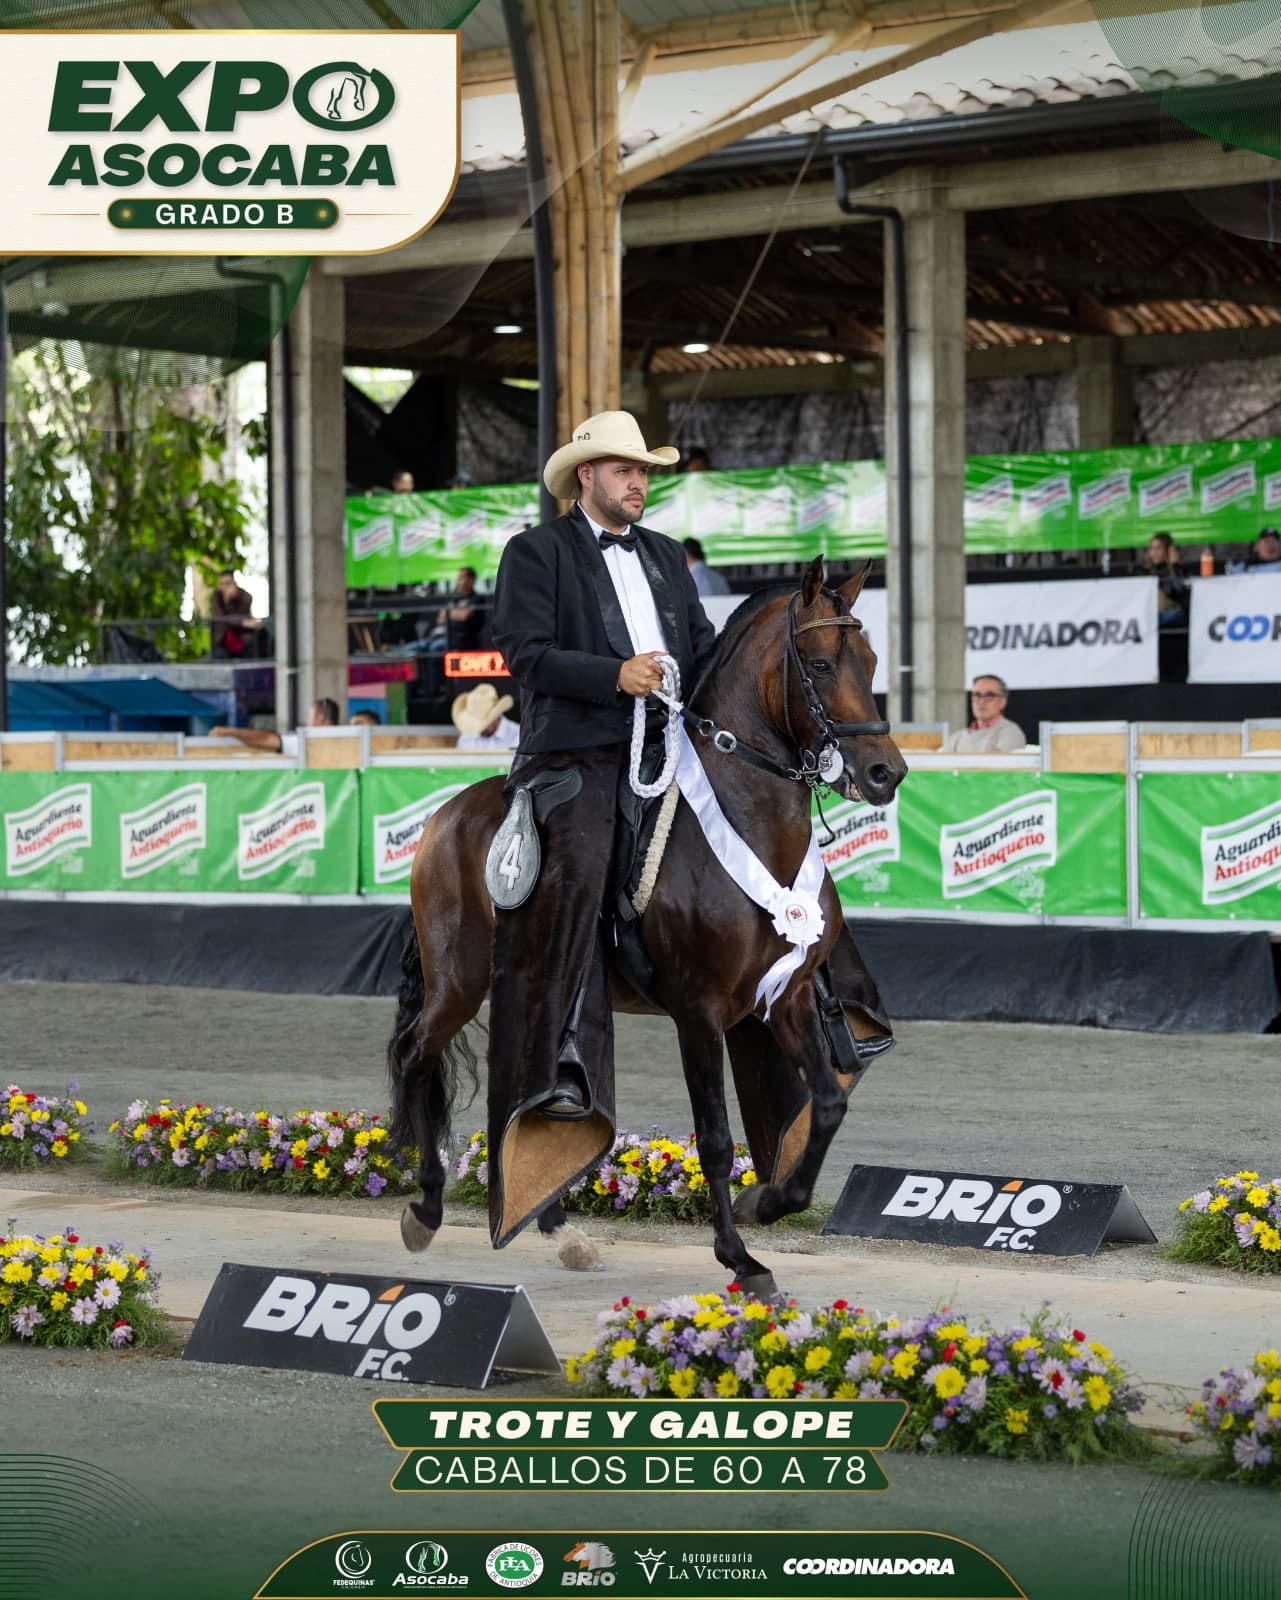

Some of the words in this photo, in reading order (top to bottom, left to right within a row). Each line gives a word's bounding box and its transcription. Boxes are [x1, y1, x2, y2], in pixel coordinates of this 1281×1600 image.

[965, 618, 1142, 651] RDINADORA
[953, 813, 1044, 858] Aguardiente
[954, 829, 1045, 876] Antioqueño
[499, 833, 521, 890] 4
[983, 1226, 1037, 1251] F.C.
[353, 1347, 412, 1381] F.C.
